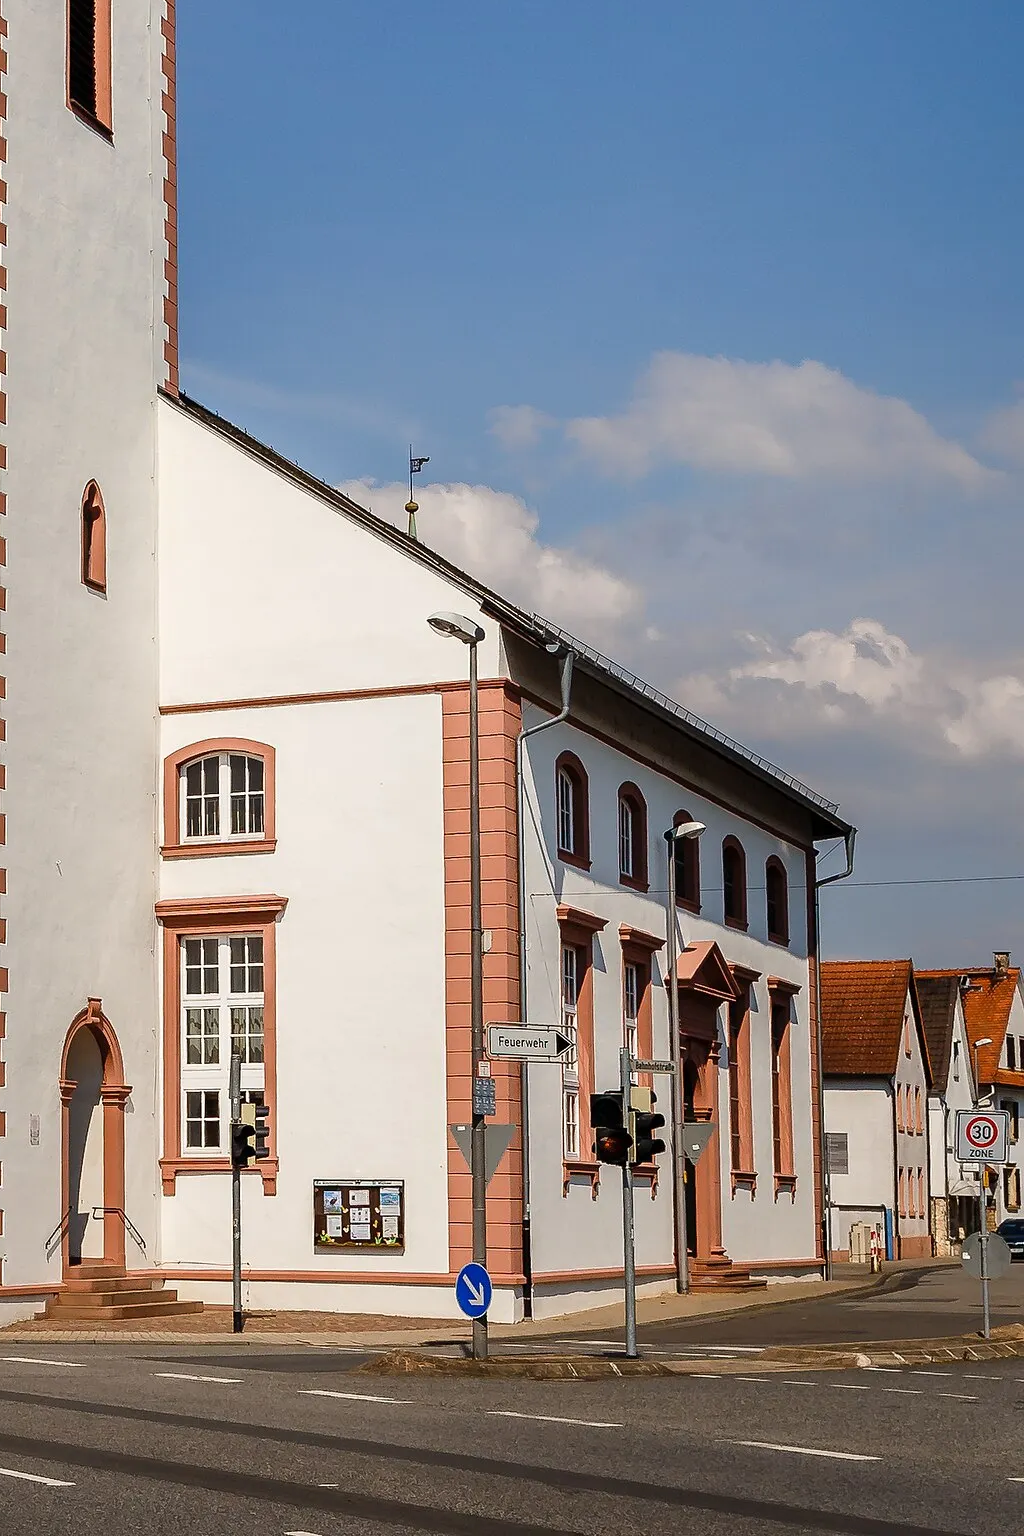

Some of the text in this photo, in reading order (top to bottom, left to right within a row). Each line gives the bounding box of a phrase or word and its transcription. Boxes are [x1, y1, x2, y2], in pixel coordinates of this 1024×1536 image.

[498, 1036, 549, 1049] Feuerwehr
[635, 1061, 675, 1072] Bahnhofstraße
[972, 1125, 992, 1140] 30
[969, 1149, 994, 1158] ZONE
